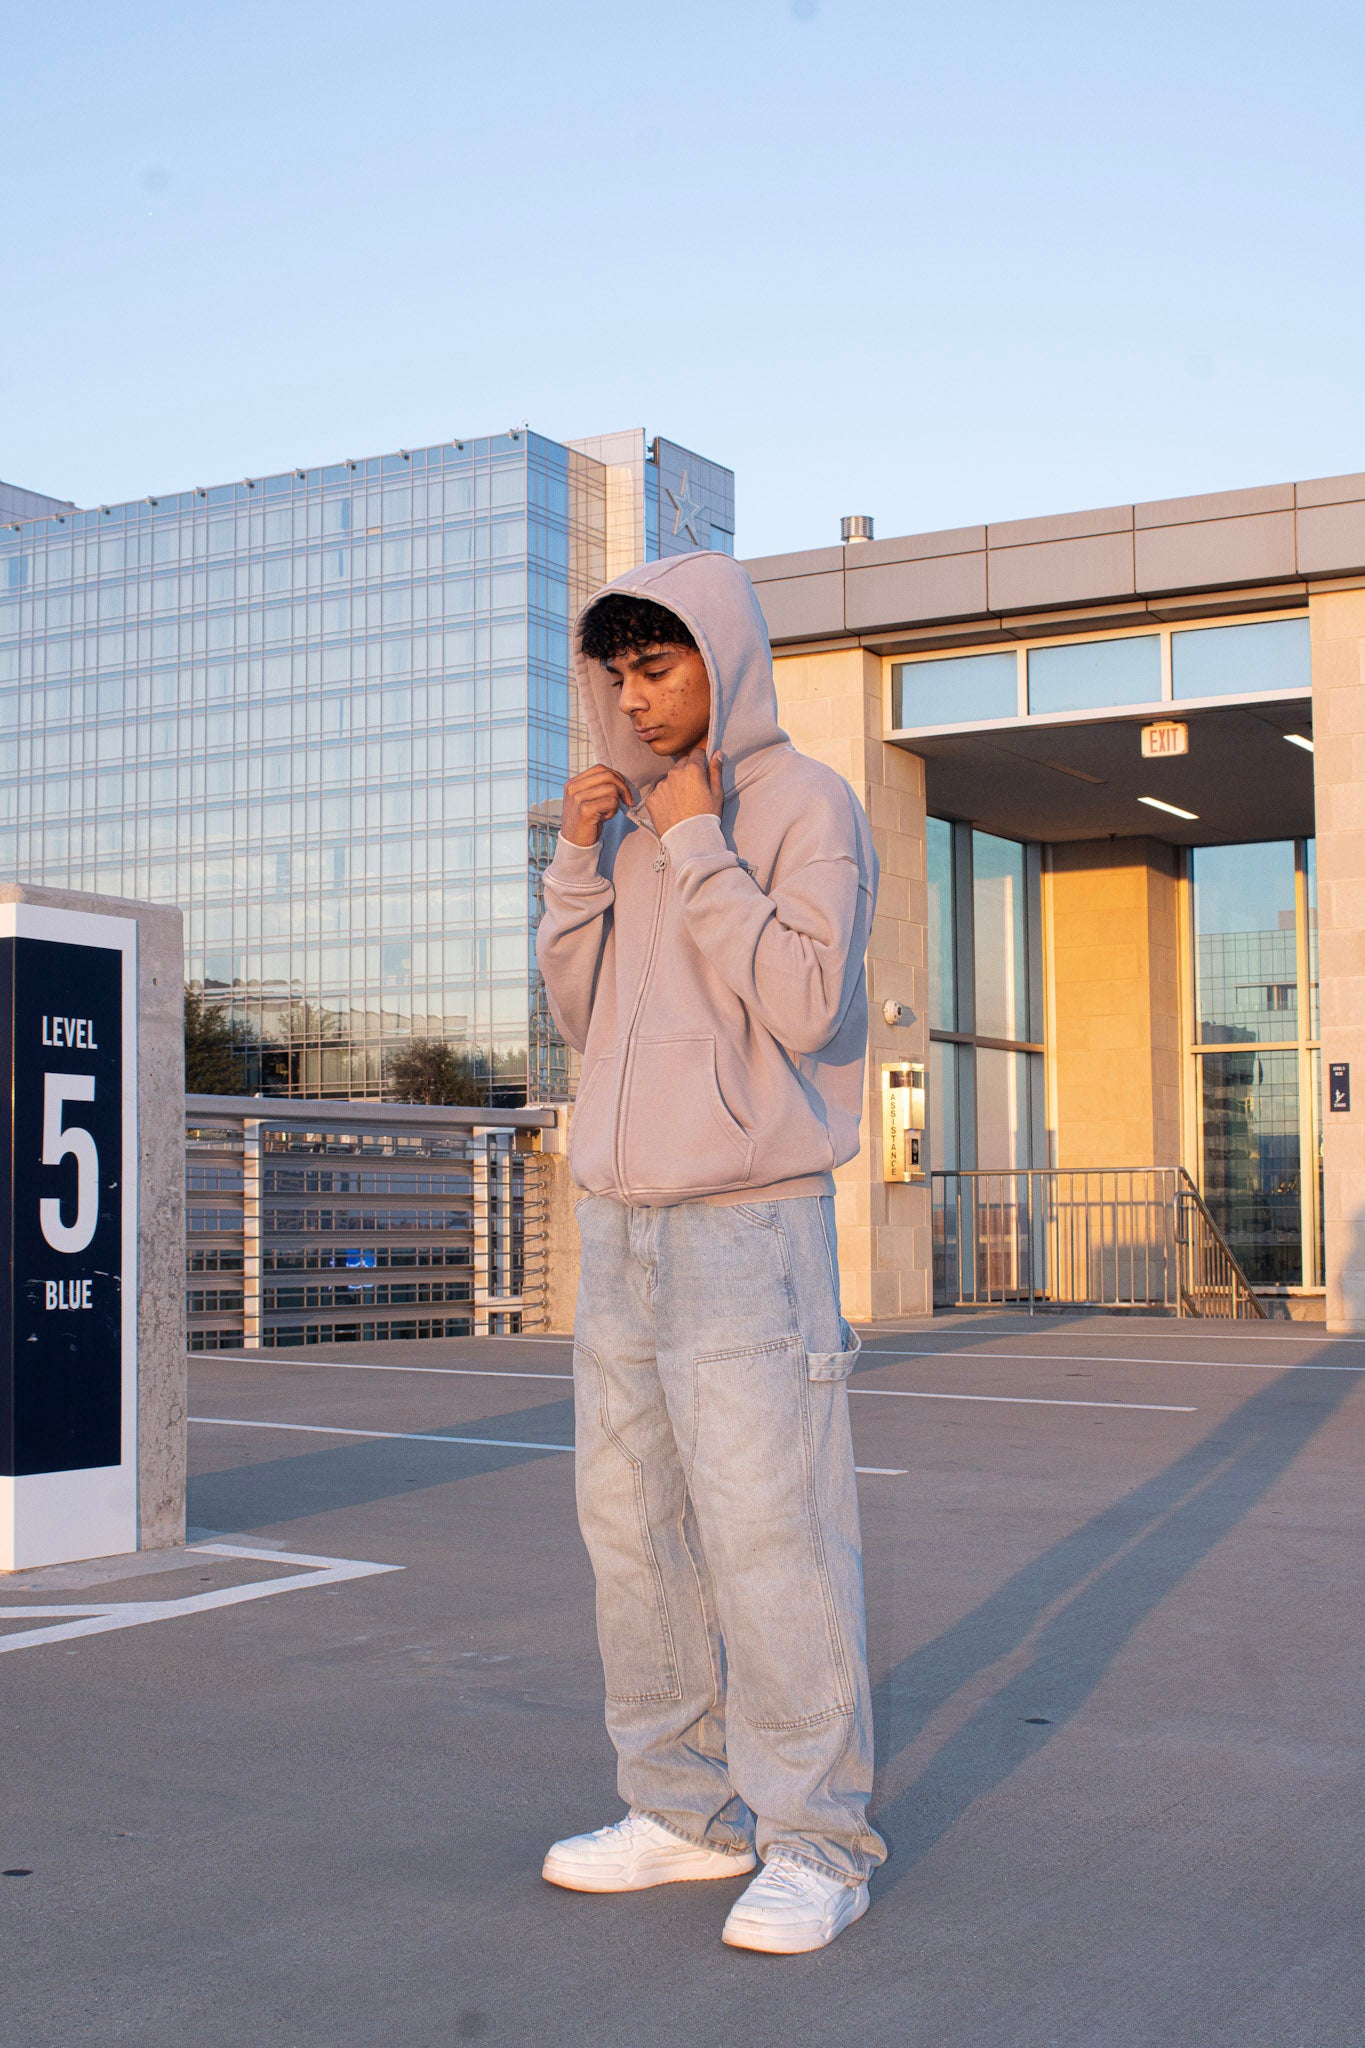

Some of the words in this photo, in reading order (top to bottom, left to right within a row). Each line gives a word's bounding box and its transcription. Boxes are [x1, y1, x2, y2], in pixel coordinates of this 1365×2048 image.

[1149, 727, 1179, 753] EXIT
[42, 1015, 98, 1050] LEVEL
[39, 1072, 99, 1254] 5
[45, 1279, 93, 1311] BLUE
